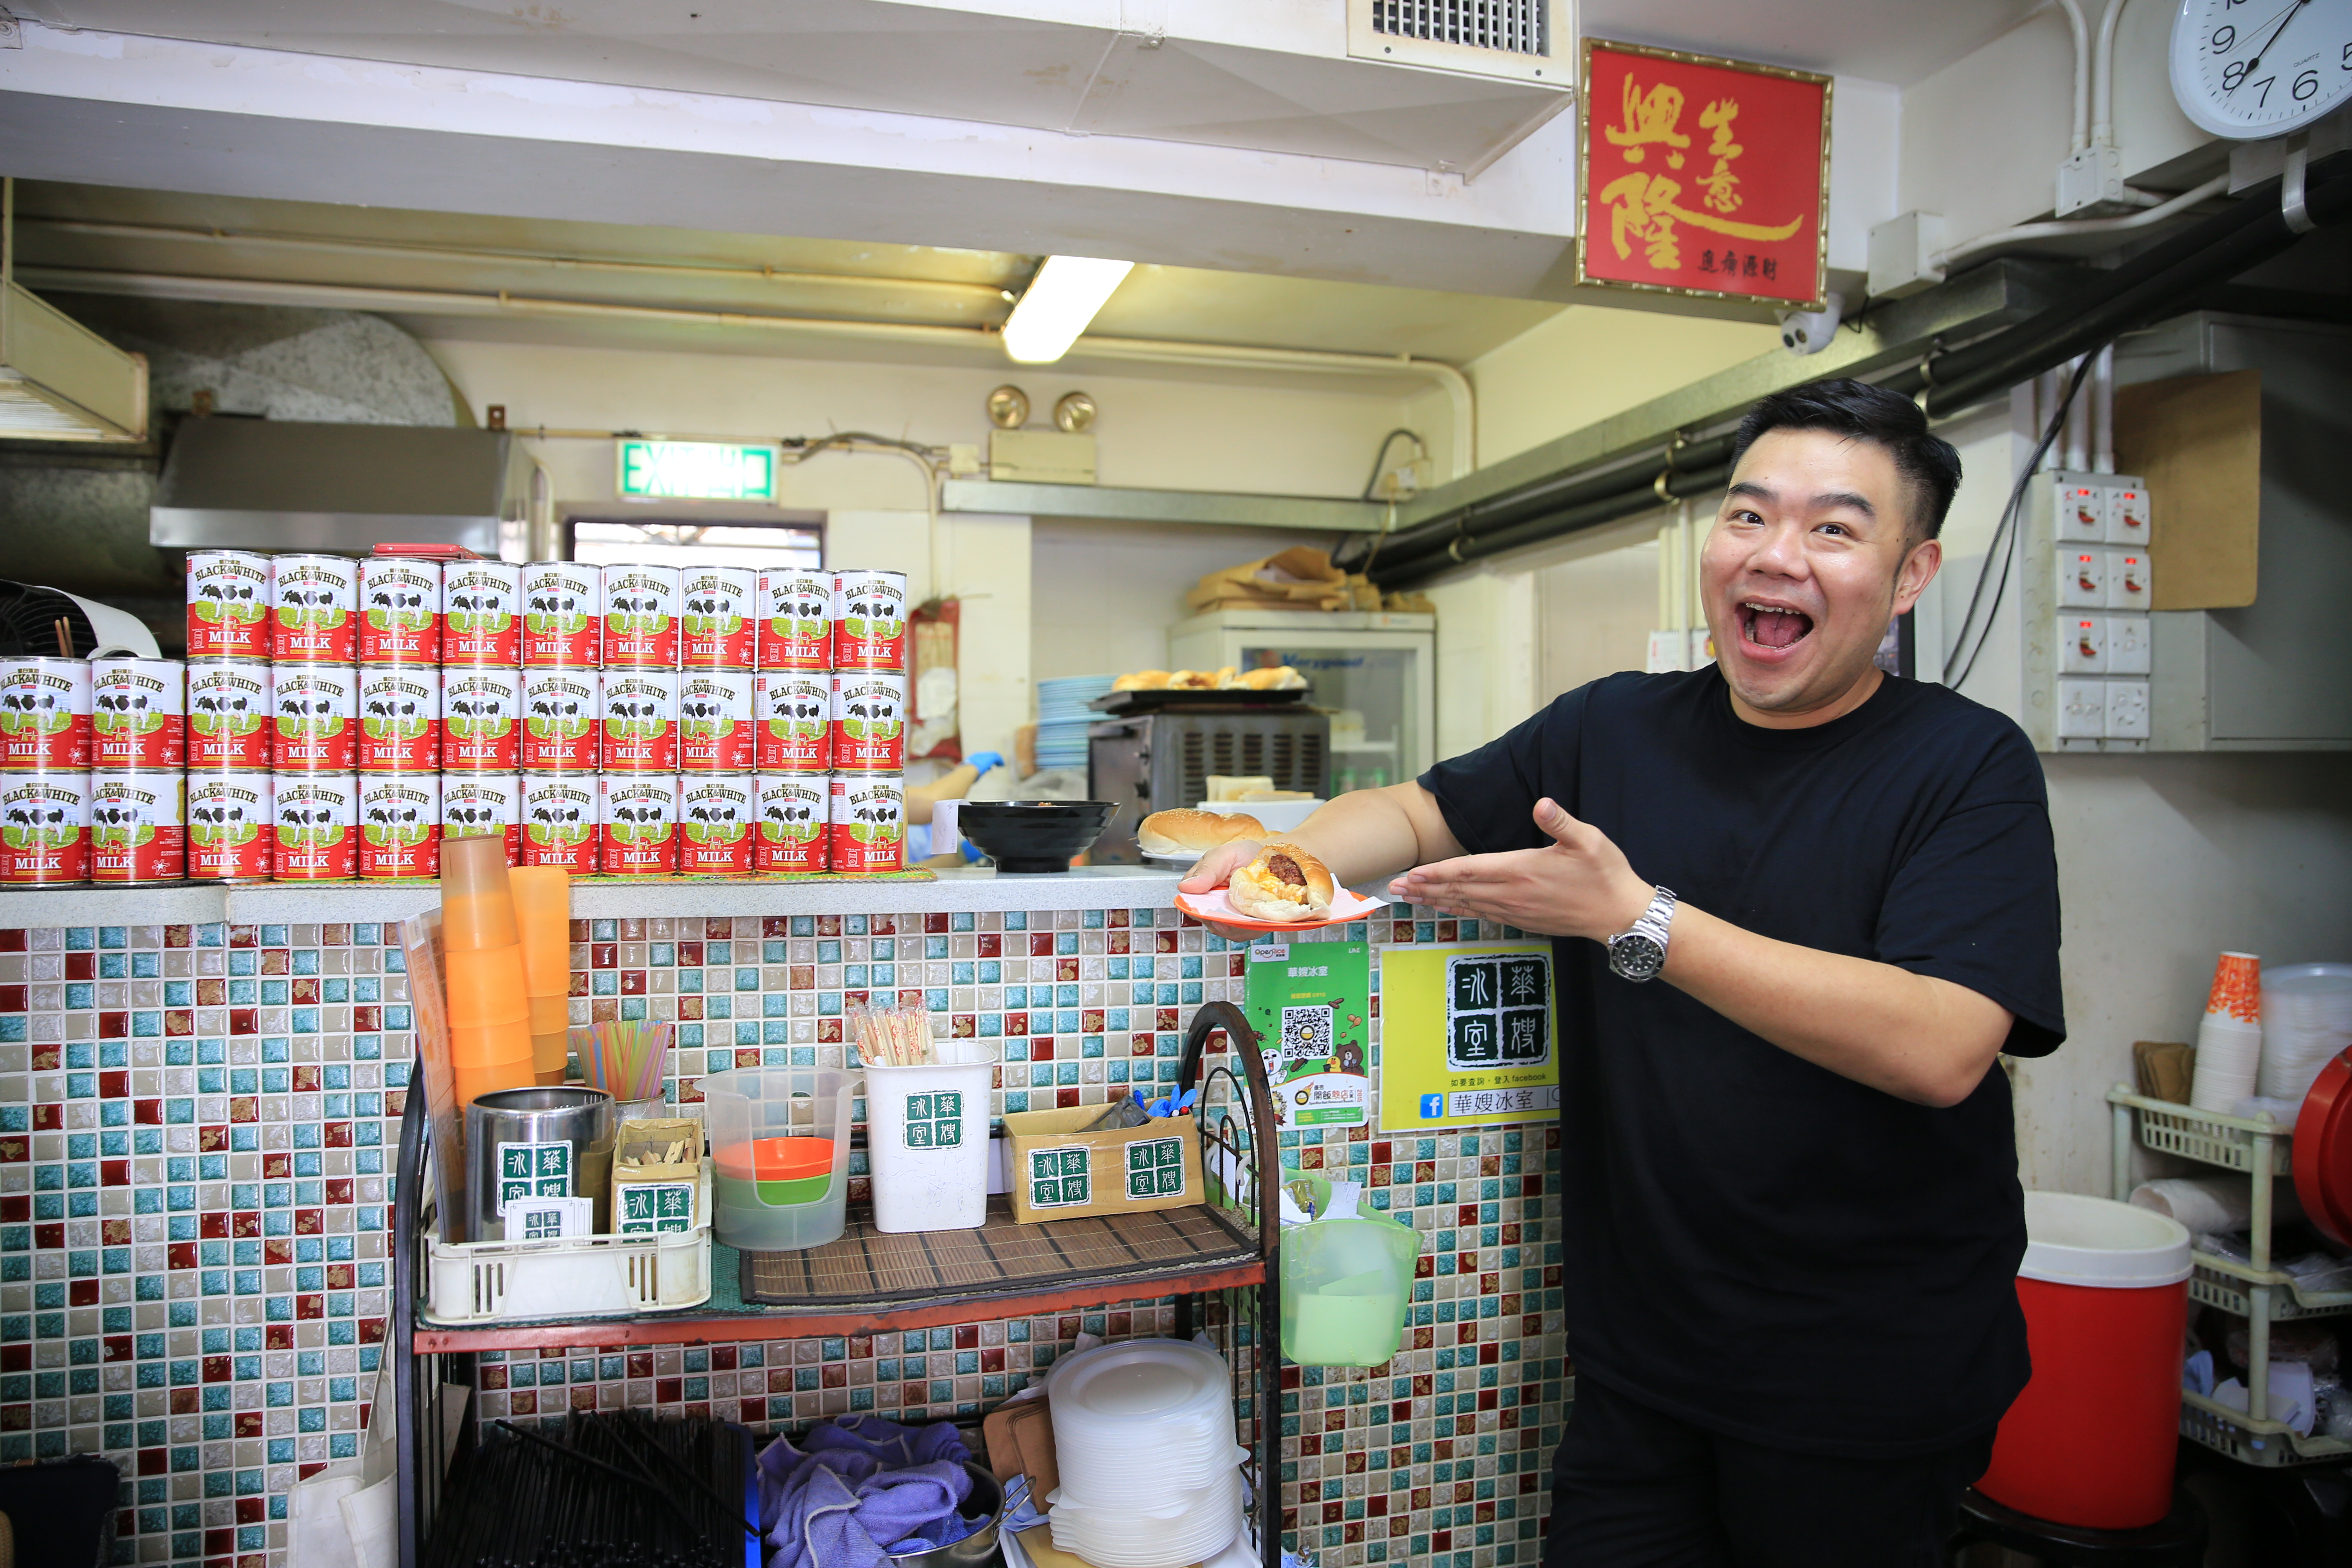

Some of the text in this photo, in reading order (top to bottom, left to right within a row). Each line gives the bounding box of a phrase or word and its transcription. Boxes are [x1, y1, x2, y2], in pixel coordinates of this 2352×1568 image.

[2212, 25, 2235, 55] 9
[2293, 53, 2320, 67] QUARTZ
[2222, 61, 2245, 91] 8
[2253, 76, 2276, 108] 7
[2292, 70, 2319, 101] 6
[195, 565, 266, 584] BLACK&WHITE
[278, 571, 347, 589] BLACK&WHITE
[368, 574, 433, 592] BLACK&WHITE
[448, 577, 512, 594] BLACK&WHITE
[527, 579, 588, 595] BLACK&WHITE
[608, 579, 670, 596] BLACK&WHITE
[684, 581, 743, 597] BLACK&WHITE
[772, 584, 830, 602] BLACK&WHITE
[845, 585, 902, 602] BLACK&WHITE
[209, 631, 251, 643] MILK
[290, 637, 331, 648] MILK
[379, 639, 419, 650] MILK
[459, 641, 497, 653] MILK
[535, 642, 572, 653] MILK
[618, 642, 655, 653] MILK
[692, 643, 727, 654] MILK
[785, 646, 819, 657] MILK
[858, 646, 892, 657] MILK
[192, 677, 262, 695] BLACK&WHITE
[276, 680, 344, 697] BLACK&WHITE
[363, 682, 429, 699] BLACK&WHITE
[448, 682, 512, 699] BLACK&WHITE
[528, 683, 591, 699] BLACK&WHITE
[606, 684, 668, 701] BLACK&WHITE
[769, 686, 828, 701] BLACK&WHITE
[843, 686, 901, 702] BLACK&WHITE
[9, 744, 52, 755] MILK
[103, 743, 145, 755] MILK
[203, 744, 245, 755] MILK
[288, 747, 328, 757] MILK
[374, 747, 413, 758] MILK
[459, 747, 497, 757] MILK
[539, 746, 576, 757] MILK
[616, 747, 652, 758] MILK
[686, 747, 718, 757] MILK
[782, 748, 817, 758] MILK
[856, 747, 890, 758] MILK
[3, 788, 80, 806] BLACK&WHITE
[92, 788, 156, 805] LACK&WHITE
[190, 788, 258, 804] BLACK&WHITE
[277, 790, 345, 806] BLACK&WHITE
[364, 789, 430, 805] BLACK&WHITE
[444, 789, 506, 805] BLACK&WHITE
[528, 789, 591, 806] BLACK&WHITE
[610, 789, 672, 805] BLACK&WHITE
[686, 789, 746, 805] BLACK&WHITE
[762, 788, 821, 804] BLACK&WHITE
[97, 857, 135, 868] MILK
[200, 854, 241, 866] MILK
[288, 856, 329, 867] MILK
[375, 854, 414, 866] MILK
[539, 853, 577, 864] MILK
[624, 852, 660, 863] MILK
[697, 851, 733, 862] MILK
[772, 851, 807, 861] MILK
[864, 851, 896, 861] MILK
[15, 858, 61, 869] MILK
[1287, 966, 1328, 977] 華嫂冰室
[1512, 1073, 1546, 1082] facebook
[1314, 1090, 1348, 1100] 開飯熱店
[1454, 1091, 1533, 1114] 華嫂冰室
